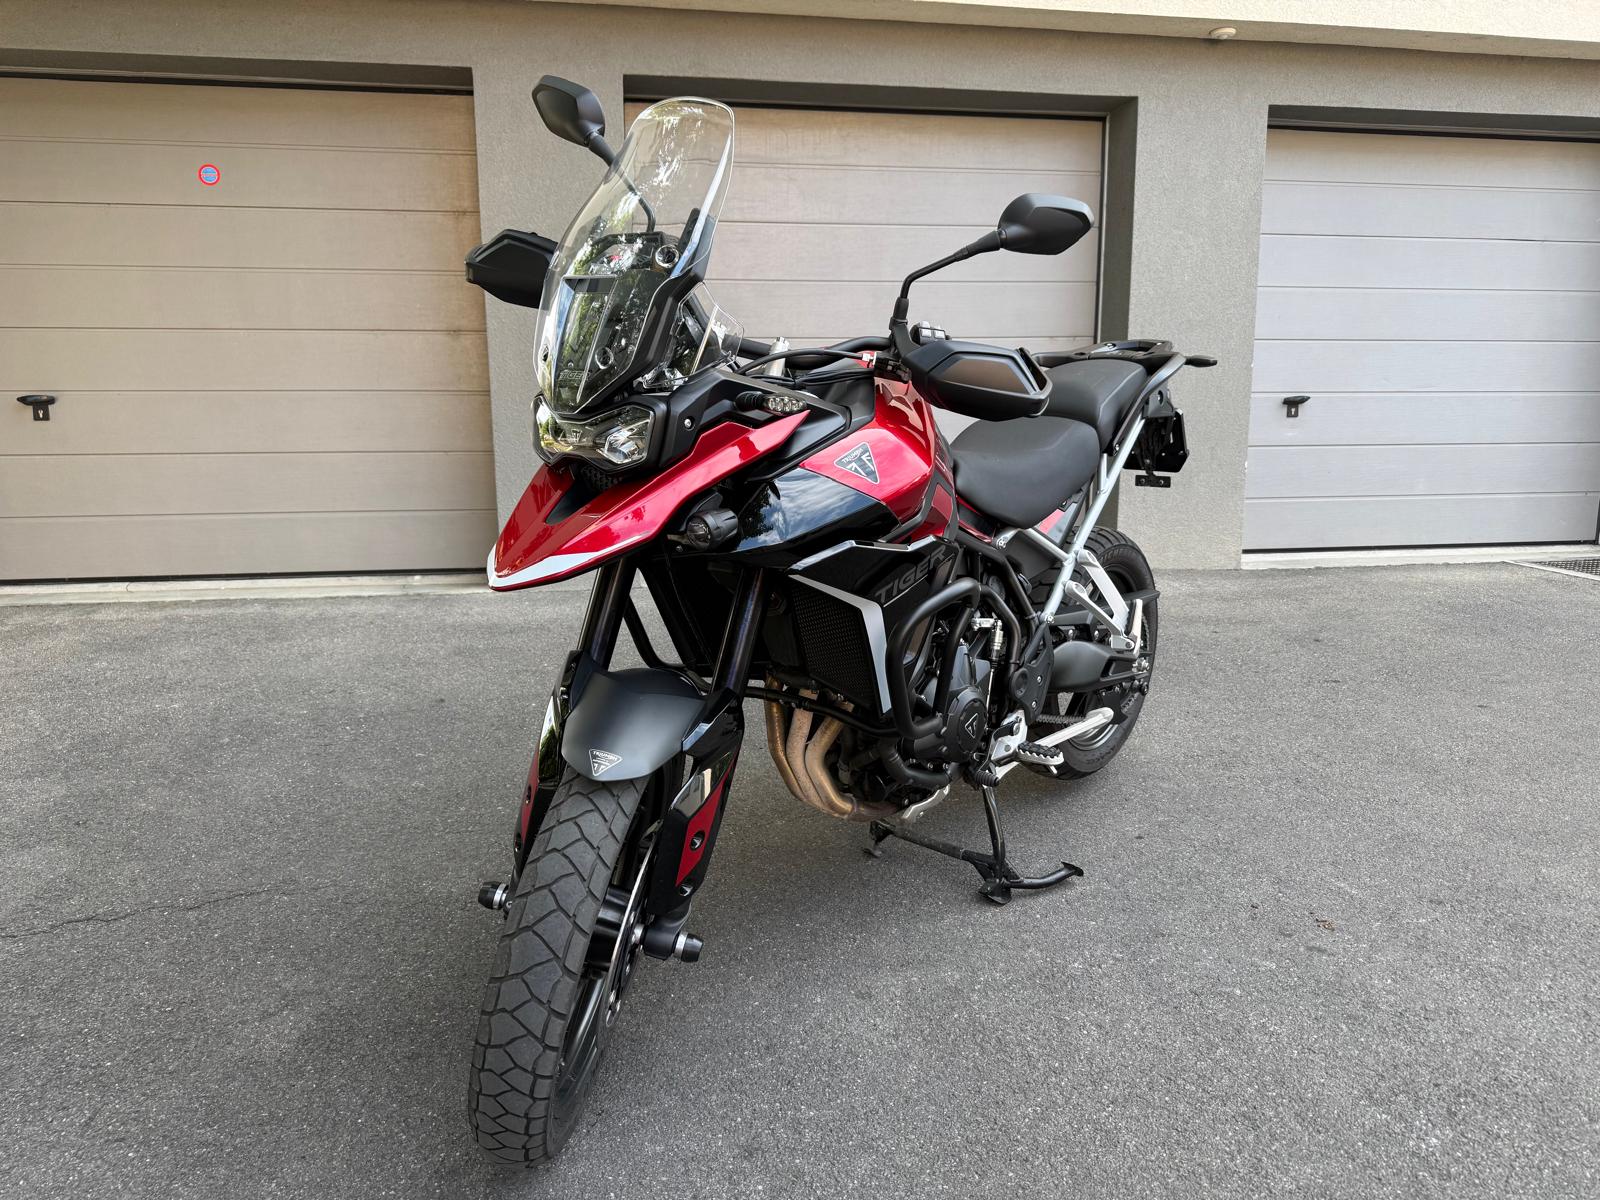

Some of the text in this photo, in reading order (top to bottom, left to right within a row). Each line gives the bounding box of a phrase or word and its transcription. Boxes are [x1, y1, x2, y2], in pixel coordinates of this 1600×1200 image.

[841, 447, 864, 462] TRIUMPH
[874, 545, 946, 603] TIGER
[593, 751, 617, 762] TRIUMPH
